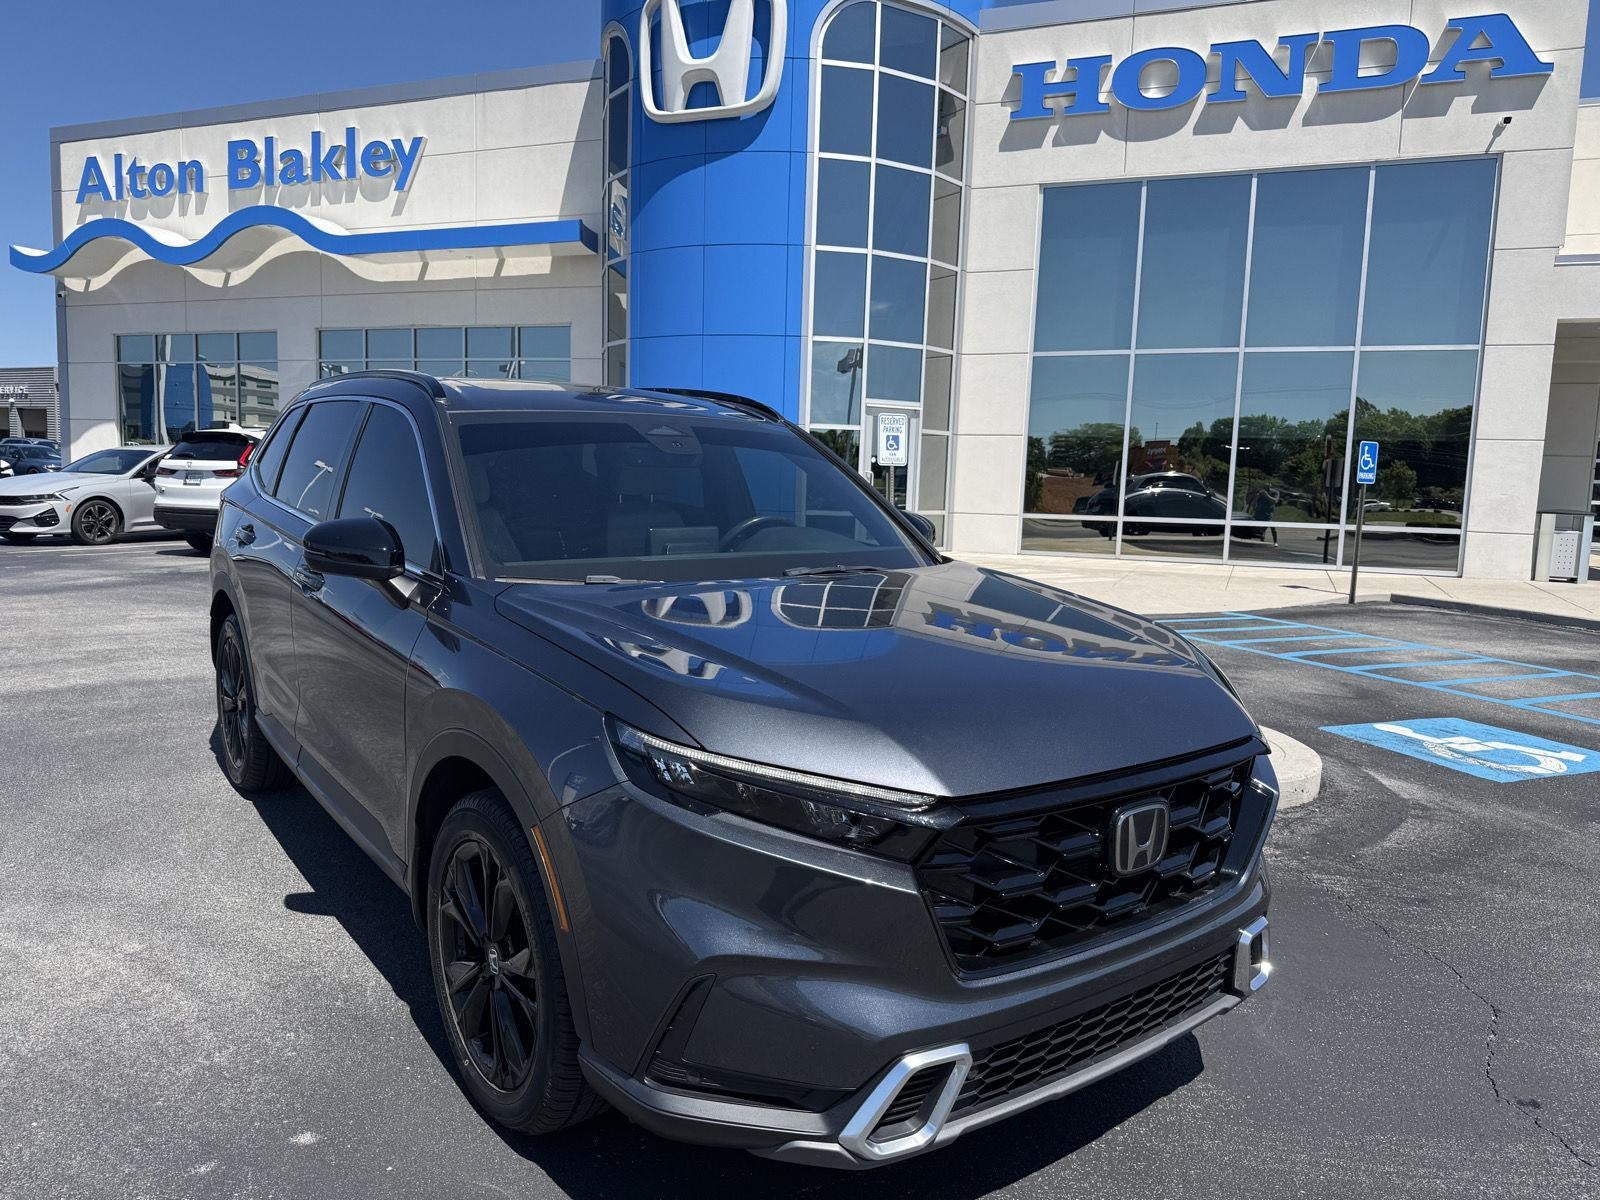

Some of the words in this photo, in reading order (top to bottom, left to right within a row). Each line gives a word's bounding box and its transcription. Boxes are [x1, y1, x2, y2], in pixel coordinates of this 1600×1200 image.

[1009, 13, 1554, 121] HONDA
[76, 153, 206, 205] Alton
[227, 126, 425, 193] Blakley
[880, 417, 905, 426] RESERVED
[882, 426, 902, 434] PARKING
